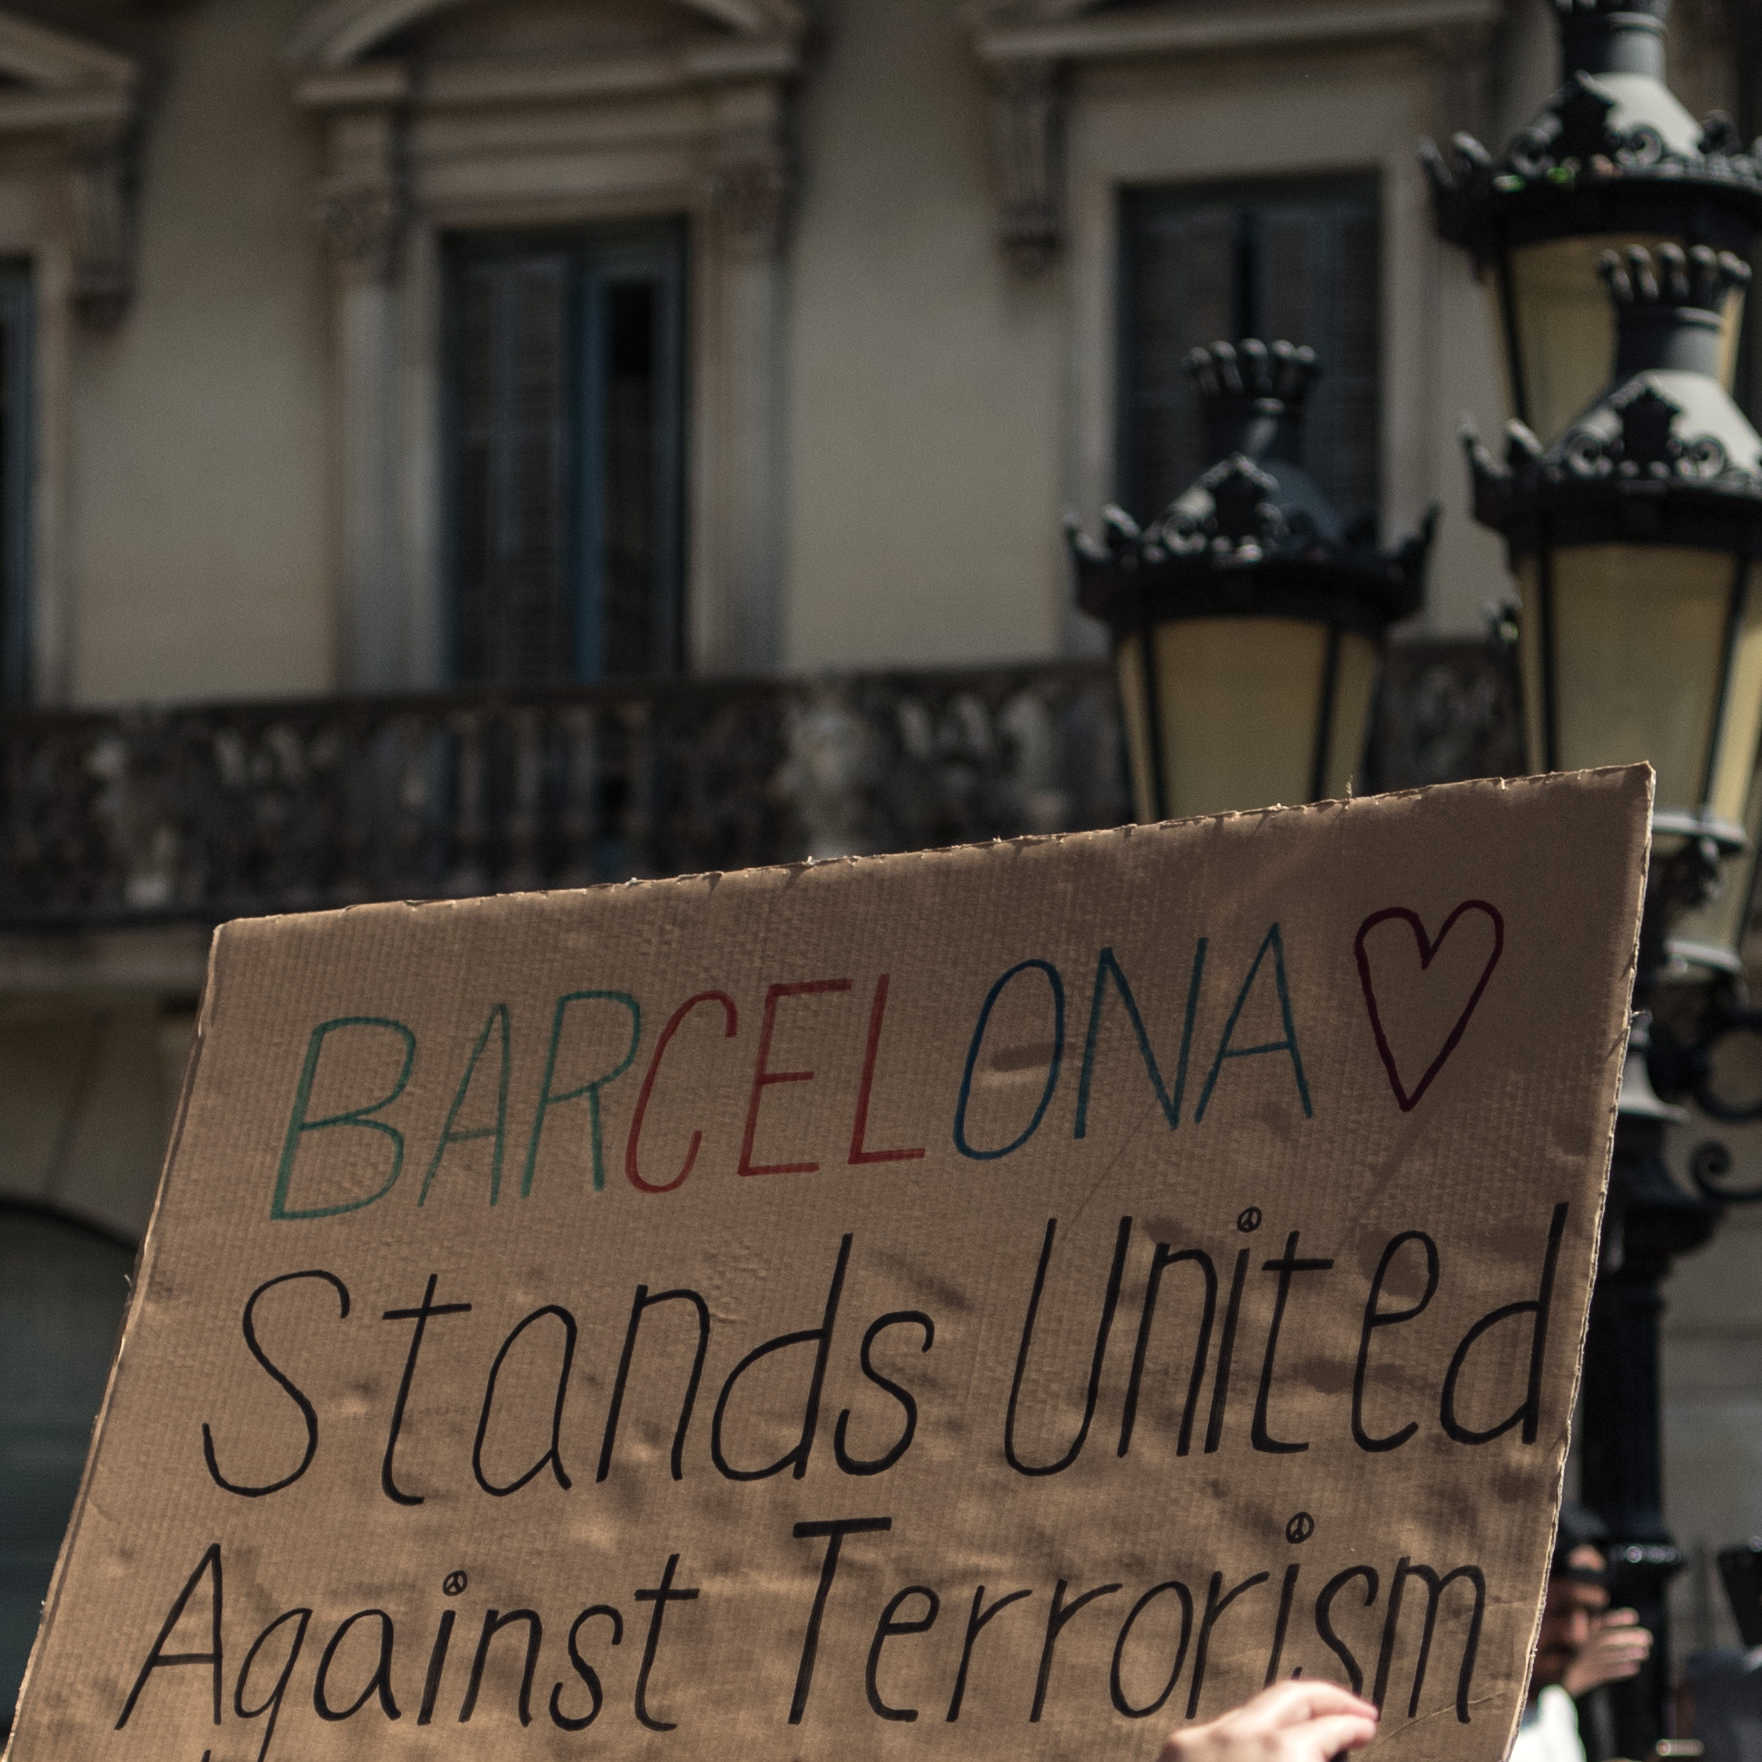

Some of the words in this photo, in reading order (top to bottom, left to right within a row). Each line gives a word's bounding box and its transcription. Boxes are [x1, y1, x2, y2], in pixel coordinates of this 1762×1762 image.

[268, 921, 1312, 1221] BARCELONA
[201, 1231, 936, 1508] Stands
[998, 1201, 1570, 1479] United
[787, 1509, 1488, 1727] Terrorism
